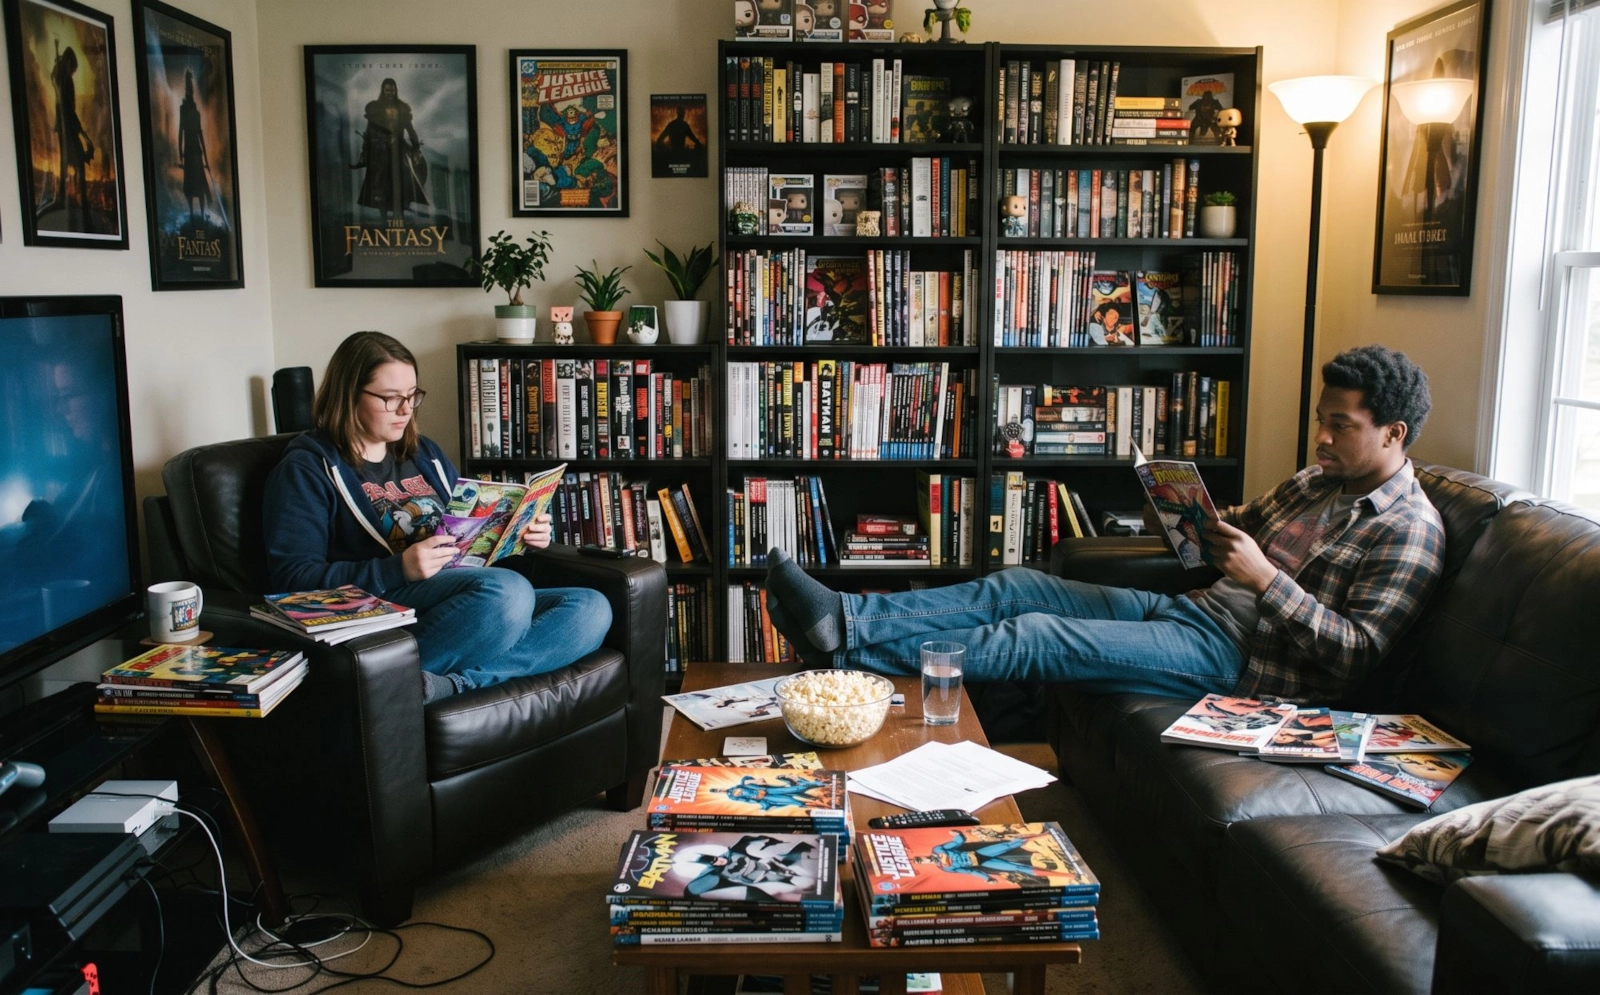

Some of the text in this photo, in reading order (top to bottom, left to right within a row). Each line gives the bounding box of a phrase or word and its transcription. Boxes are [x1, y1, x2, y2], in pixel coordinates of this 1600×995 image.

[540, 69, 607, 89] JUSTICE
[386, 219, 404, 227] THE
[343, 226, 449, 256] FANTASY
[667, 769, 690, 804] JUSTICE
[681, 771, 702, 803] LEAGUE
[637, 833, 679, 890] BATMAN
[870, 833, 901, 881] JUSTICE
[886, 835, 916, 878] LEAGUE
